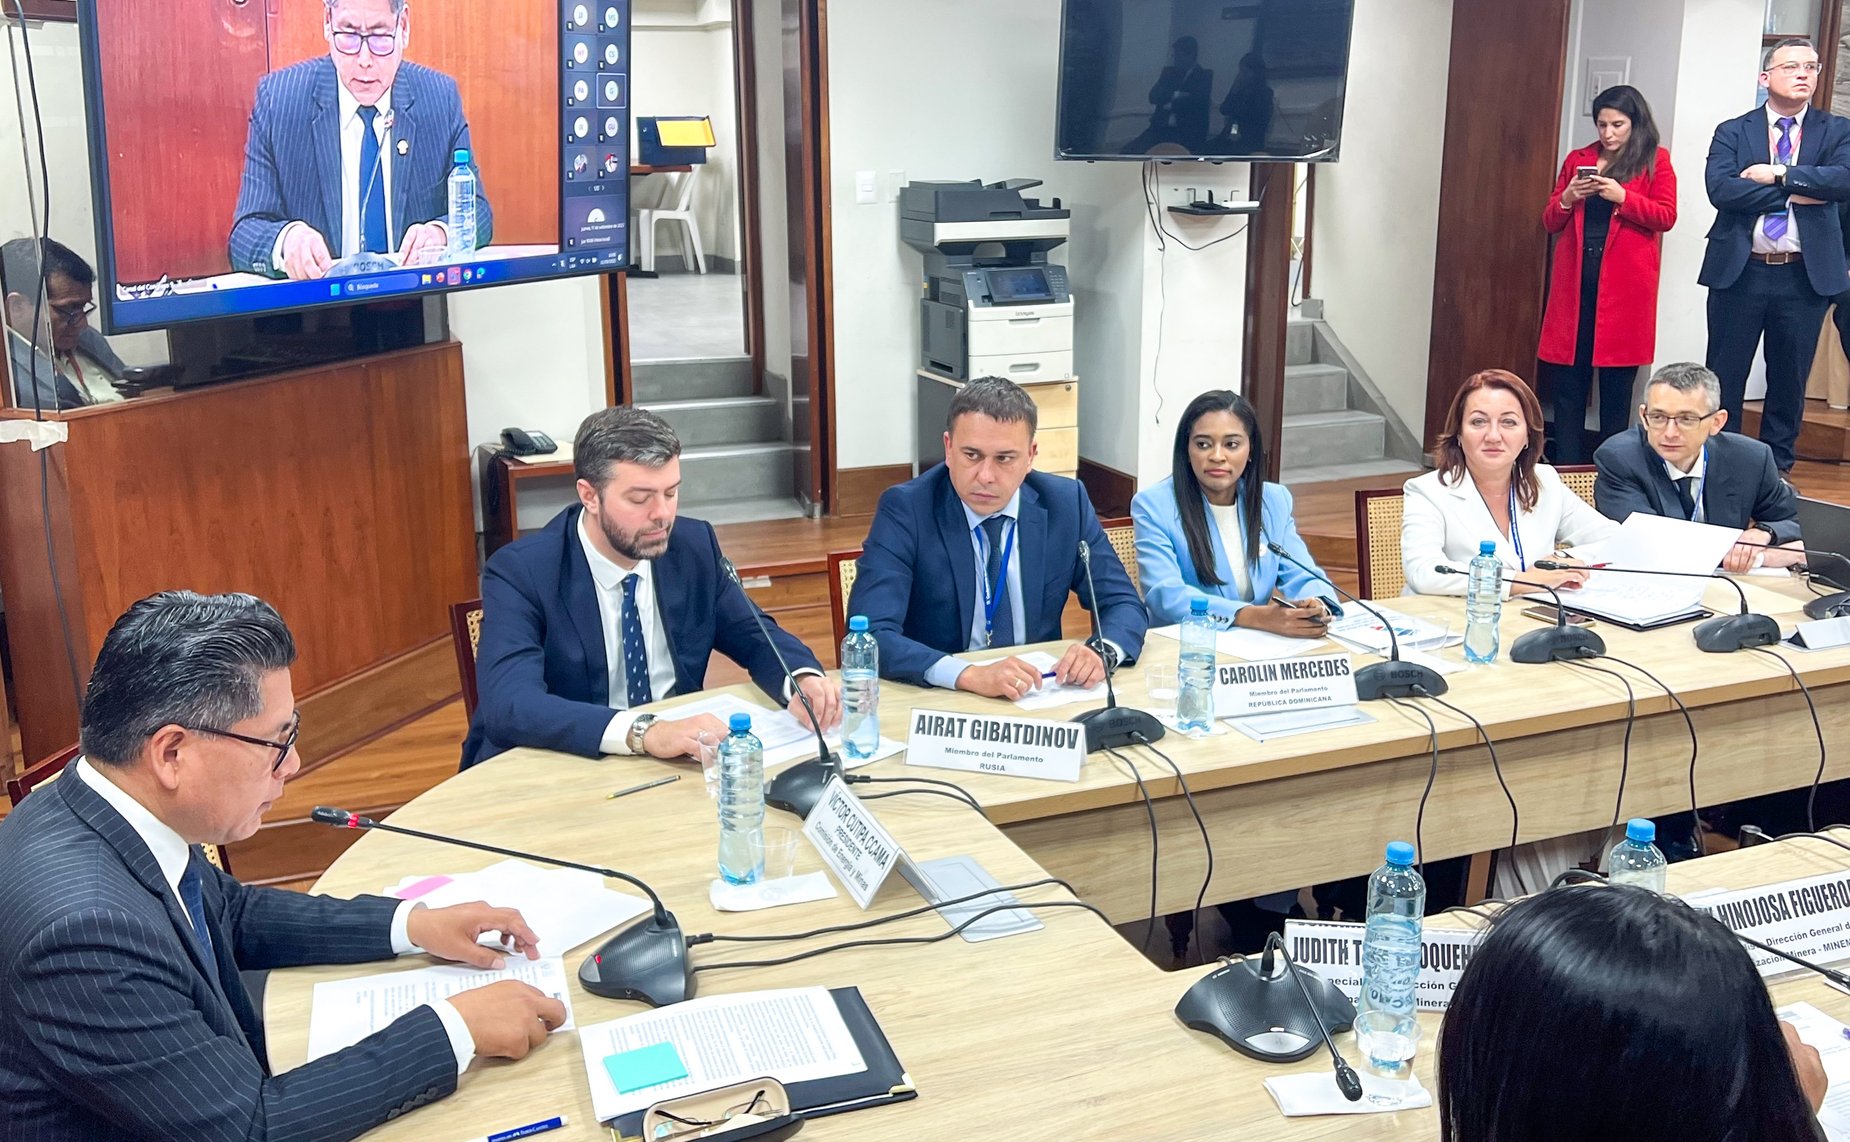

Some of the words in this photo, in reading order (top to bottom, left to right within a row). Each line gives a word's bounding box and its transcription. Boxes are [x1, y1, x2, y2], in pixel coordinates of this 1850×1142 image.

[1219, 663, 1278, 685] CAROLIN
[1280, 658, 1350, 681] MERCEDES
[1390, 669, 1423, 679] BOSCH
[1249, 689, 1278, 697] Miembro
[1291, 685, 1329, 694] Parlamento
[914, 714, 968, 739] AIRAT
[969, 719, 1079, 750] GIBATDINOV
[944, 747, 980, 757] Miembro
[981, 751, 995, 759] del
[996, 752, 1044, 763] Parlamento
[979, 762, 1006, 772] RUSIA
[834, 825, 863, 861] PRESIDENTE
[846, 813, 870, 847] CUTIPA
[864, 835, 890, 870] CCAMA
[1716, 892, 1793, 931] HINOJOSA
[1765, 932, 1808, 947] Dirección
[1809, 922, 1844, 938] General
[1292, 936, 1349, 966] JUDITH
